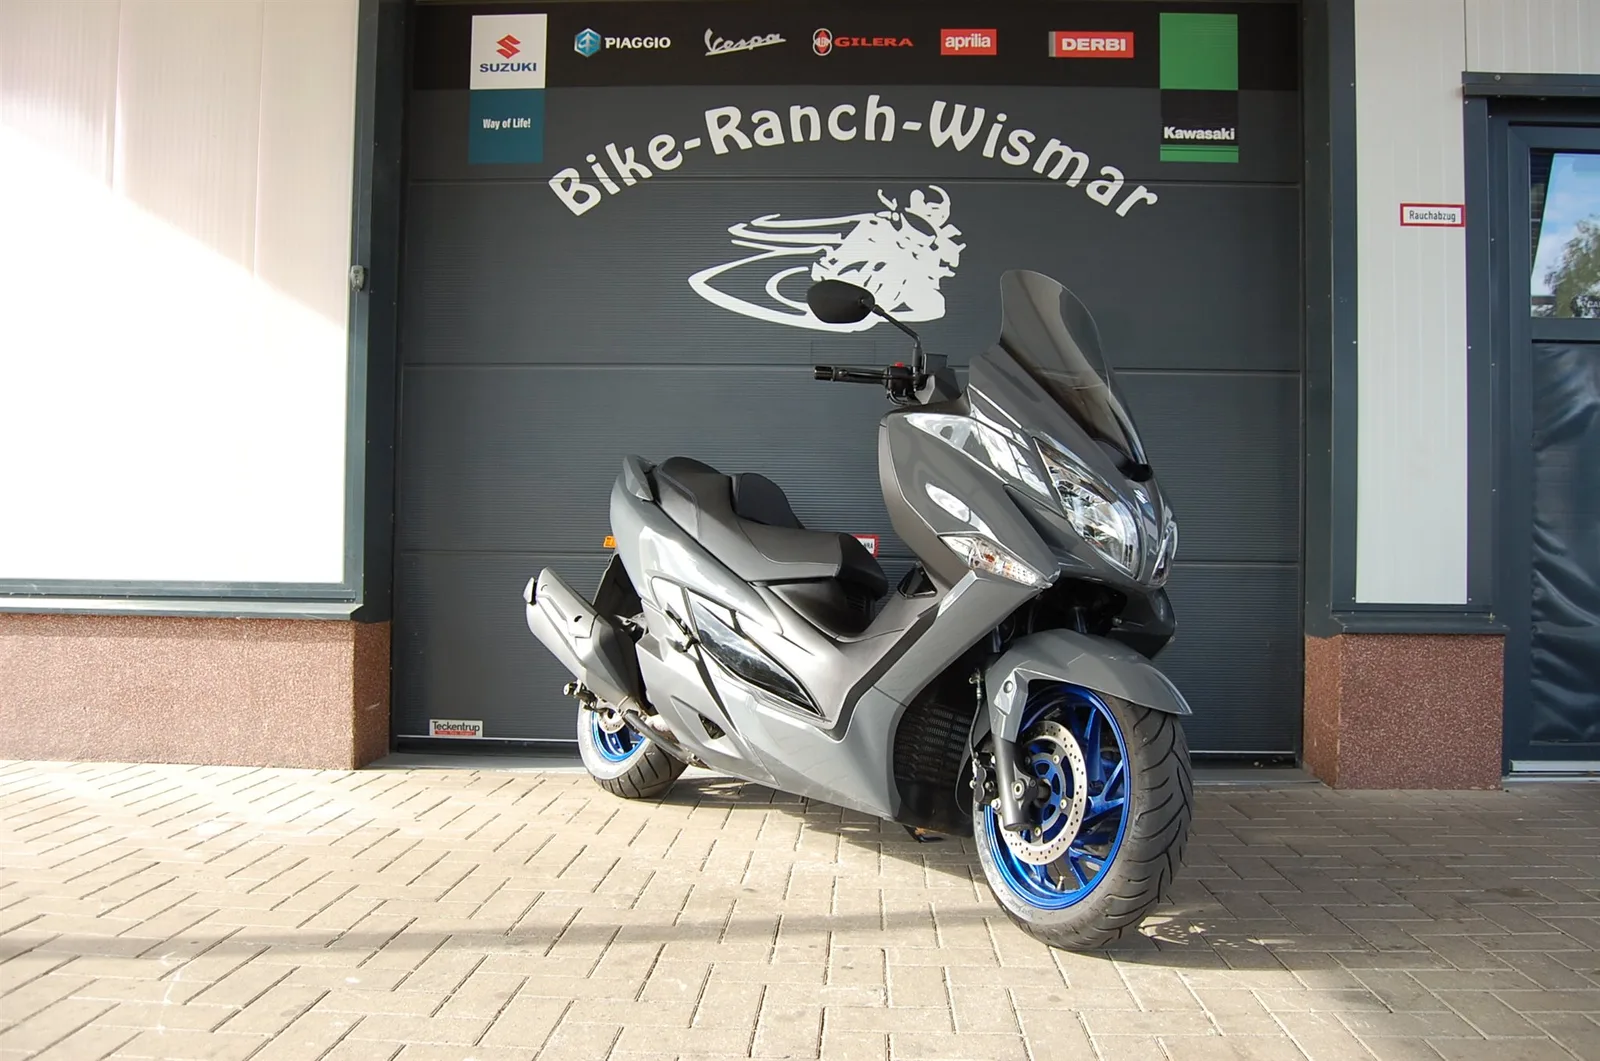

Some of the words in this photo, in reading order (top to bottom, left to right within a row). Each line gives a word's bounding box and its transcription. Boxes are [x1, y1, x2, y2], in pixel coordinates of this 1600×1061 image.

[604, 36, 672, 49] PIAGGIO
[704, 28, 787, 56] Vespa
[834, 36, 914, 48] GILERA
[945, 33, 991, 51] aprilia
[1061, 38, 1127, 52] DERBI
[479, 62, 537, 73] SUZUKI
[482, 118, 500, 131] Way
[502, 117, 511, 128] of
[512, 117, 531, 128] Life!
[1163, 126, 1236, 140] Kawasaki
[548, 94, 1159, 217] Bike-Ranch-Wismar
[1409, 210, 1456, 222] Rauchabzug
[432, 721, 480, 731] Teckentrup
